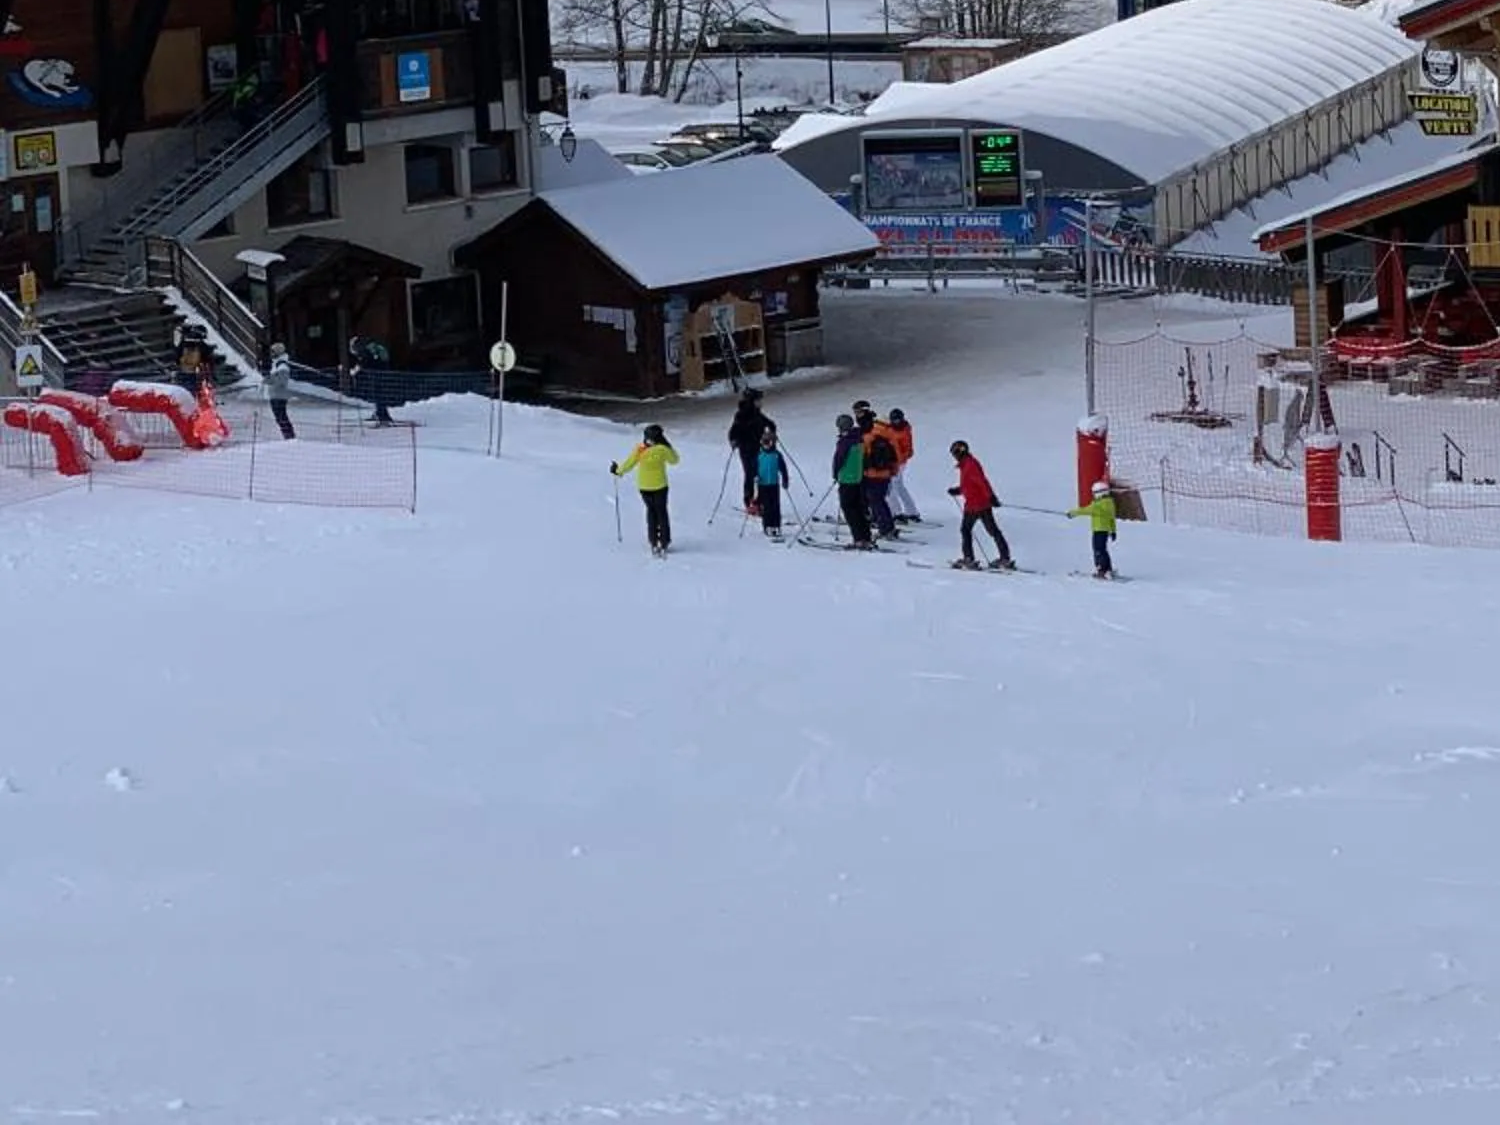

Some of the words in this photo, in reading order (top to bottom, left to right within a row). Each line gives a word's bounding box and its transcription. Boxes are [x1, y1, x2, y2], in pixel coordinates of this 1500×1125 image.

[1414, 96, 1470, 111] LOCATION
[1424, 120, 1470, 134] VENTE
[861, 214, 940, 227] HAMPIONNATS
[959, 215, 1001, 227] FRANCE
